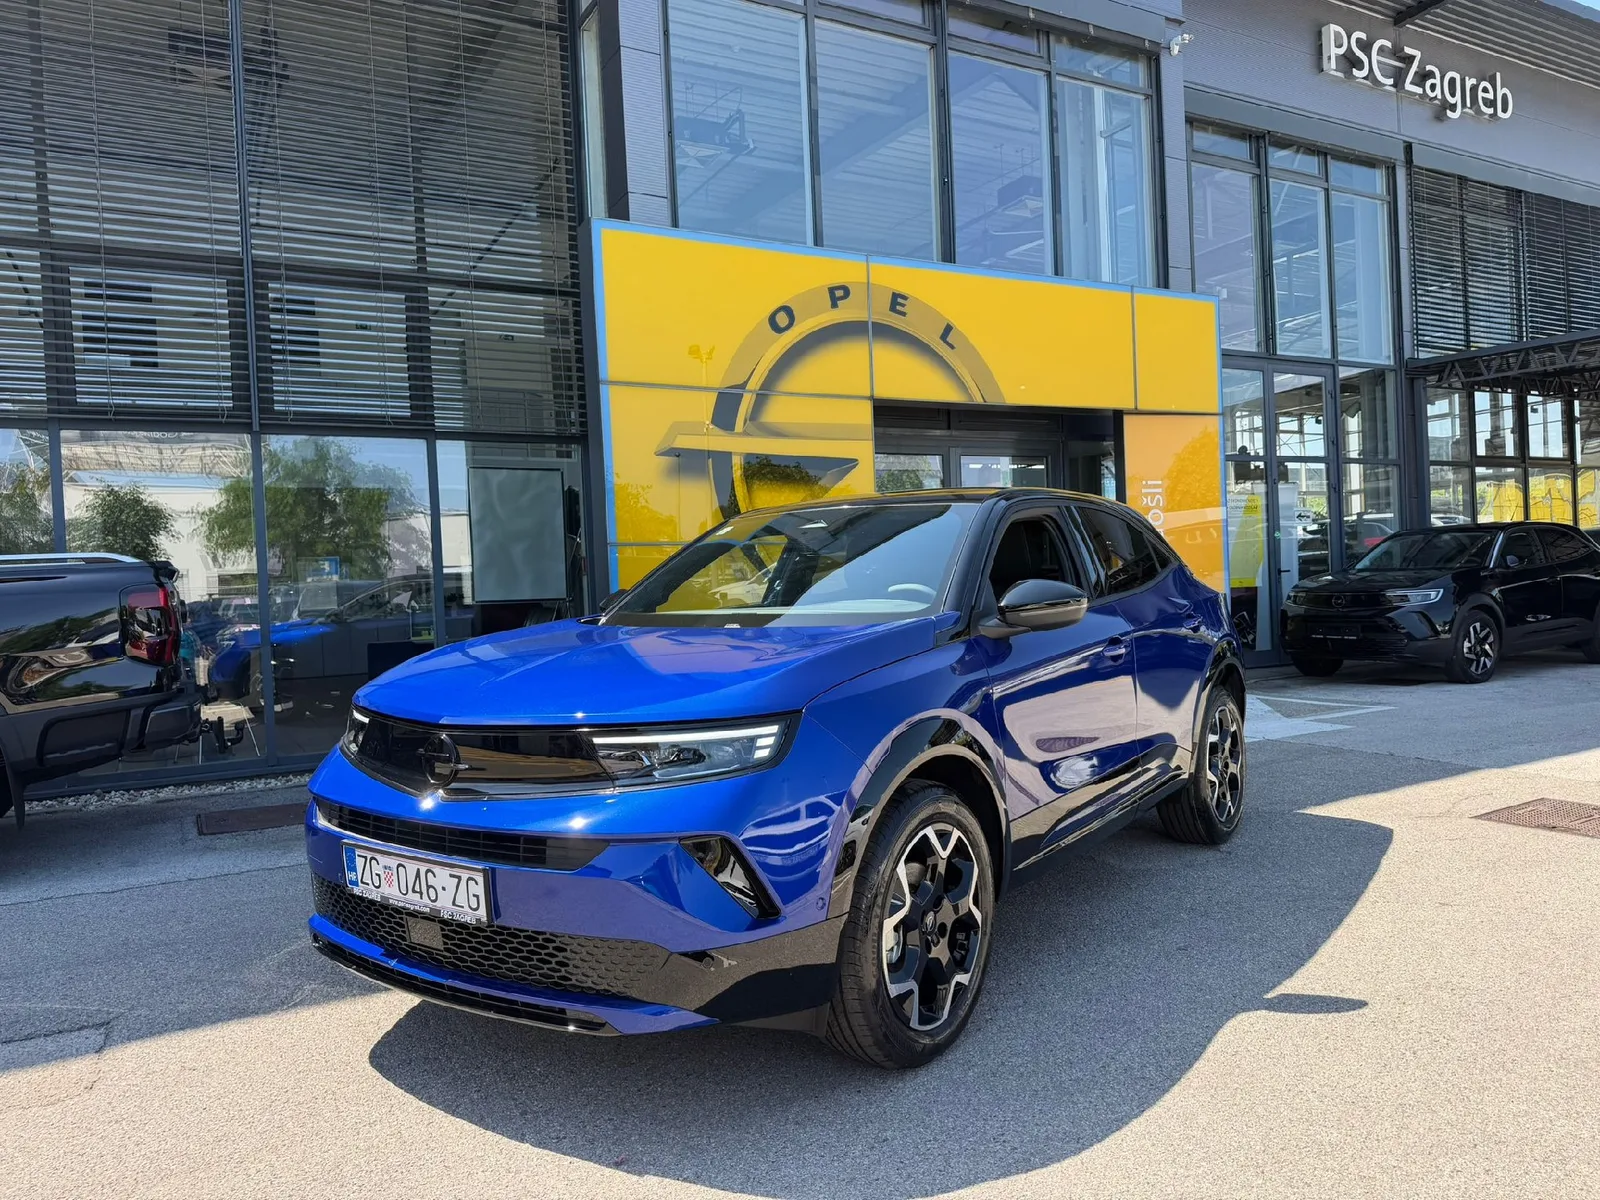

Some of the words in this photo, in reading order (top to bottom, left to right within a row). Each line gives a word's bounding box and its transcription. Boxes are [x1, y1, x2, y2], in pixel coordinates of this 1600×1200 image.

[1322, 23, 1394, 86] PSC
[1403, 46, 1513, 119] Zagreb
[768, 284, 956, 350] OPEL
[1142, 480, 1165, 538] ošli
[357, 854, 382, 889] ZG
